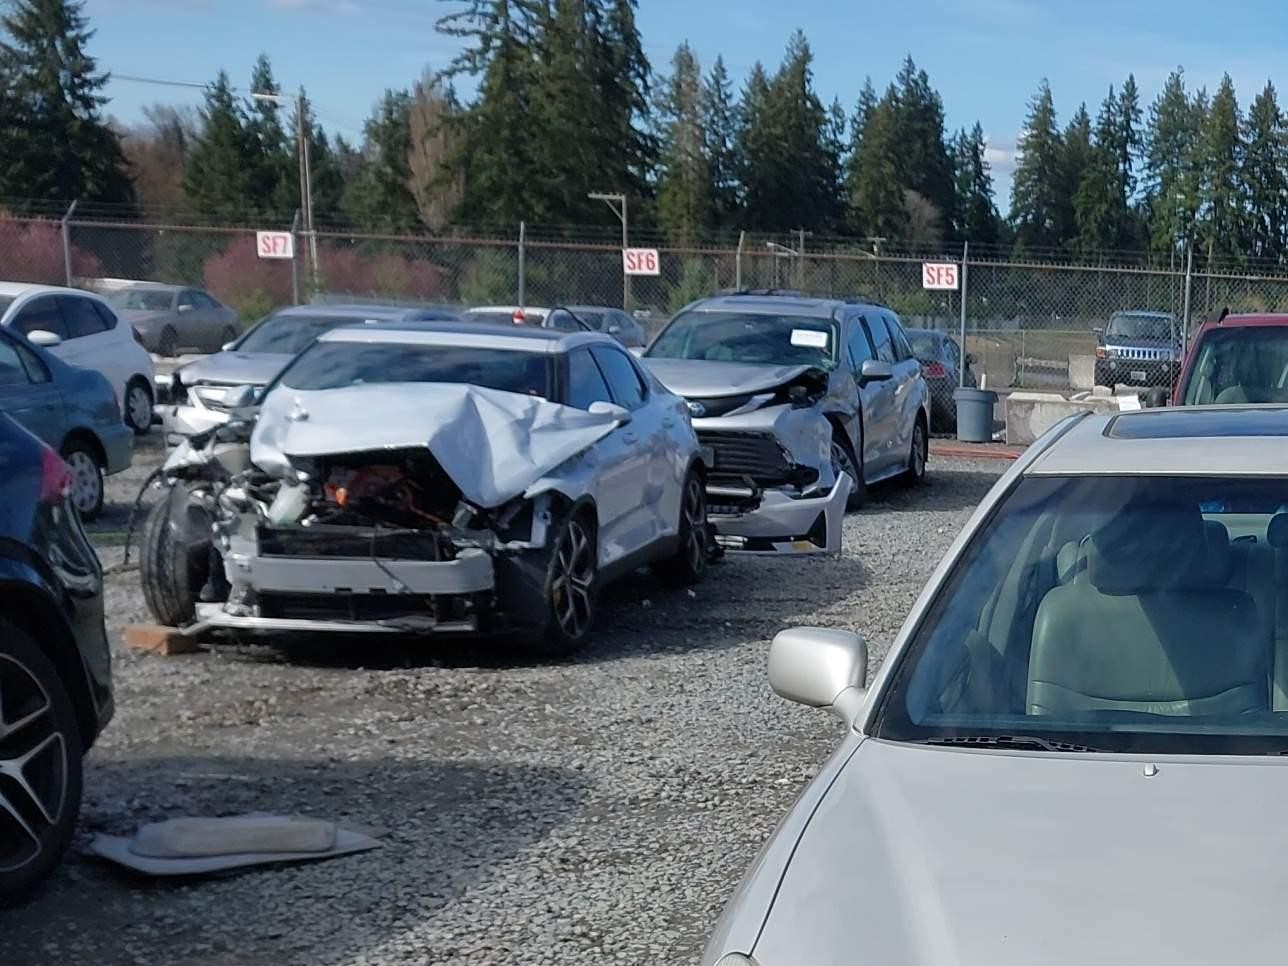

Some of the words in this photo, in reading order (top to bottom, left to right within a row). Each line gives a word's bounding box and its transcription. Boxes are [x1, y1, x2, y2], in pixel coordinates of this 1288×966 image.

[262, 235, 289, 254] SF7
[626, 252, 656, 271] SF6
[926, 266, 955, 286] SF5
